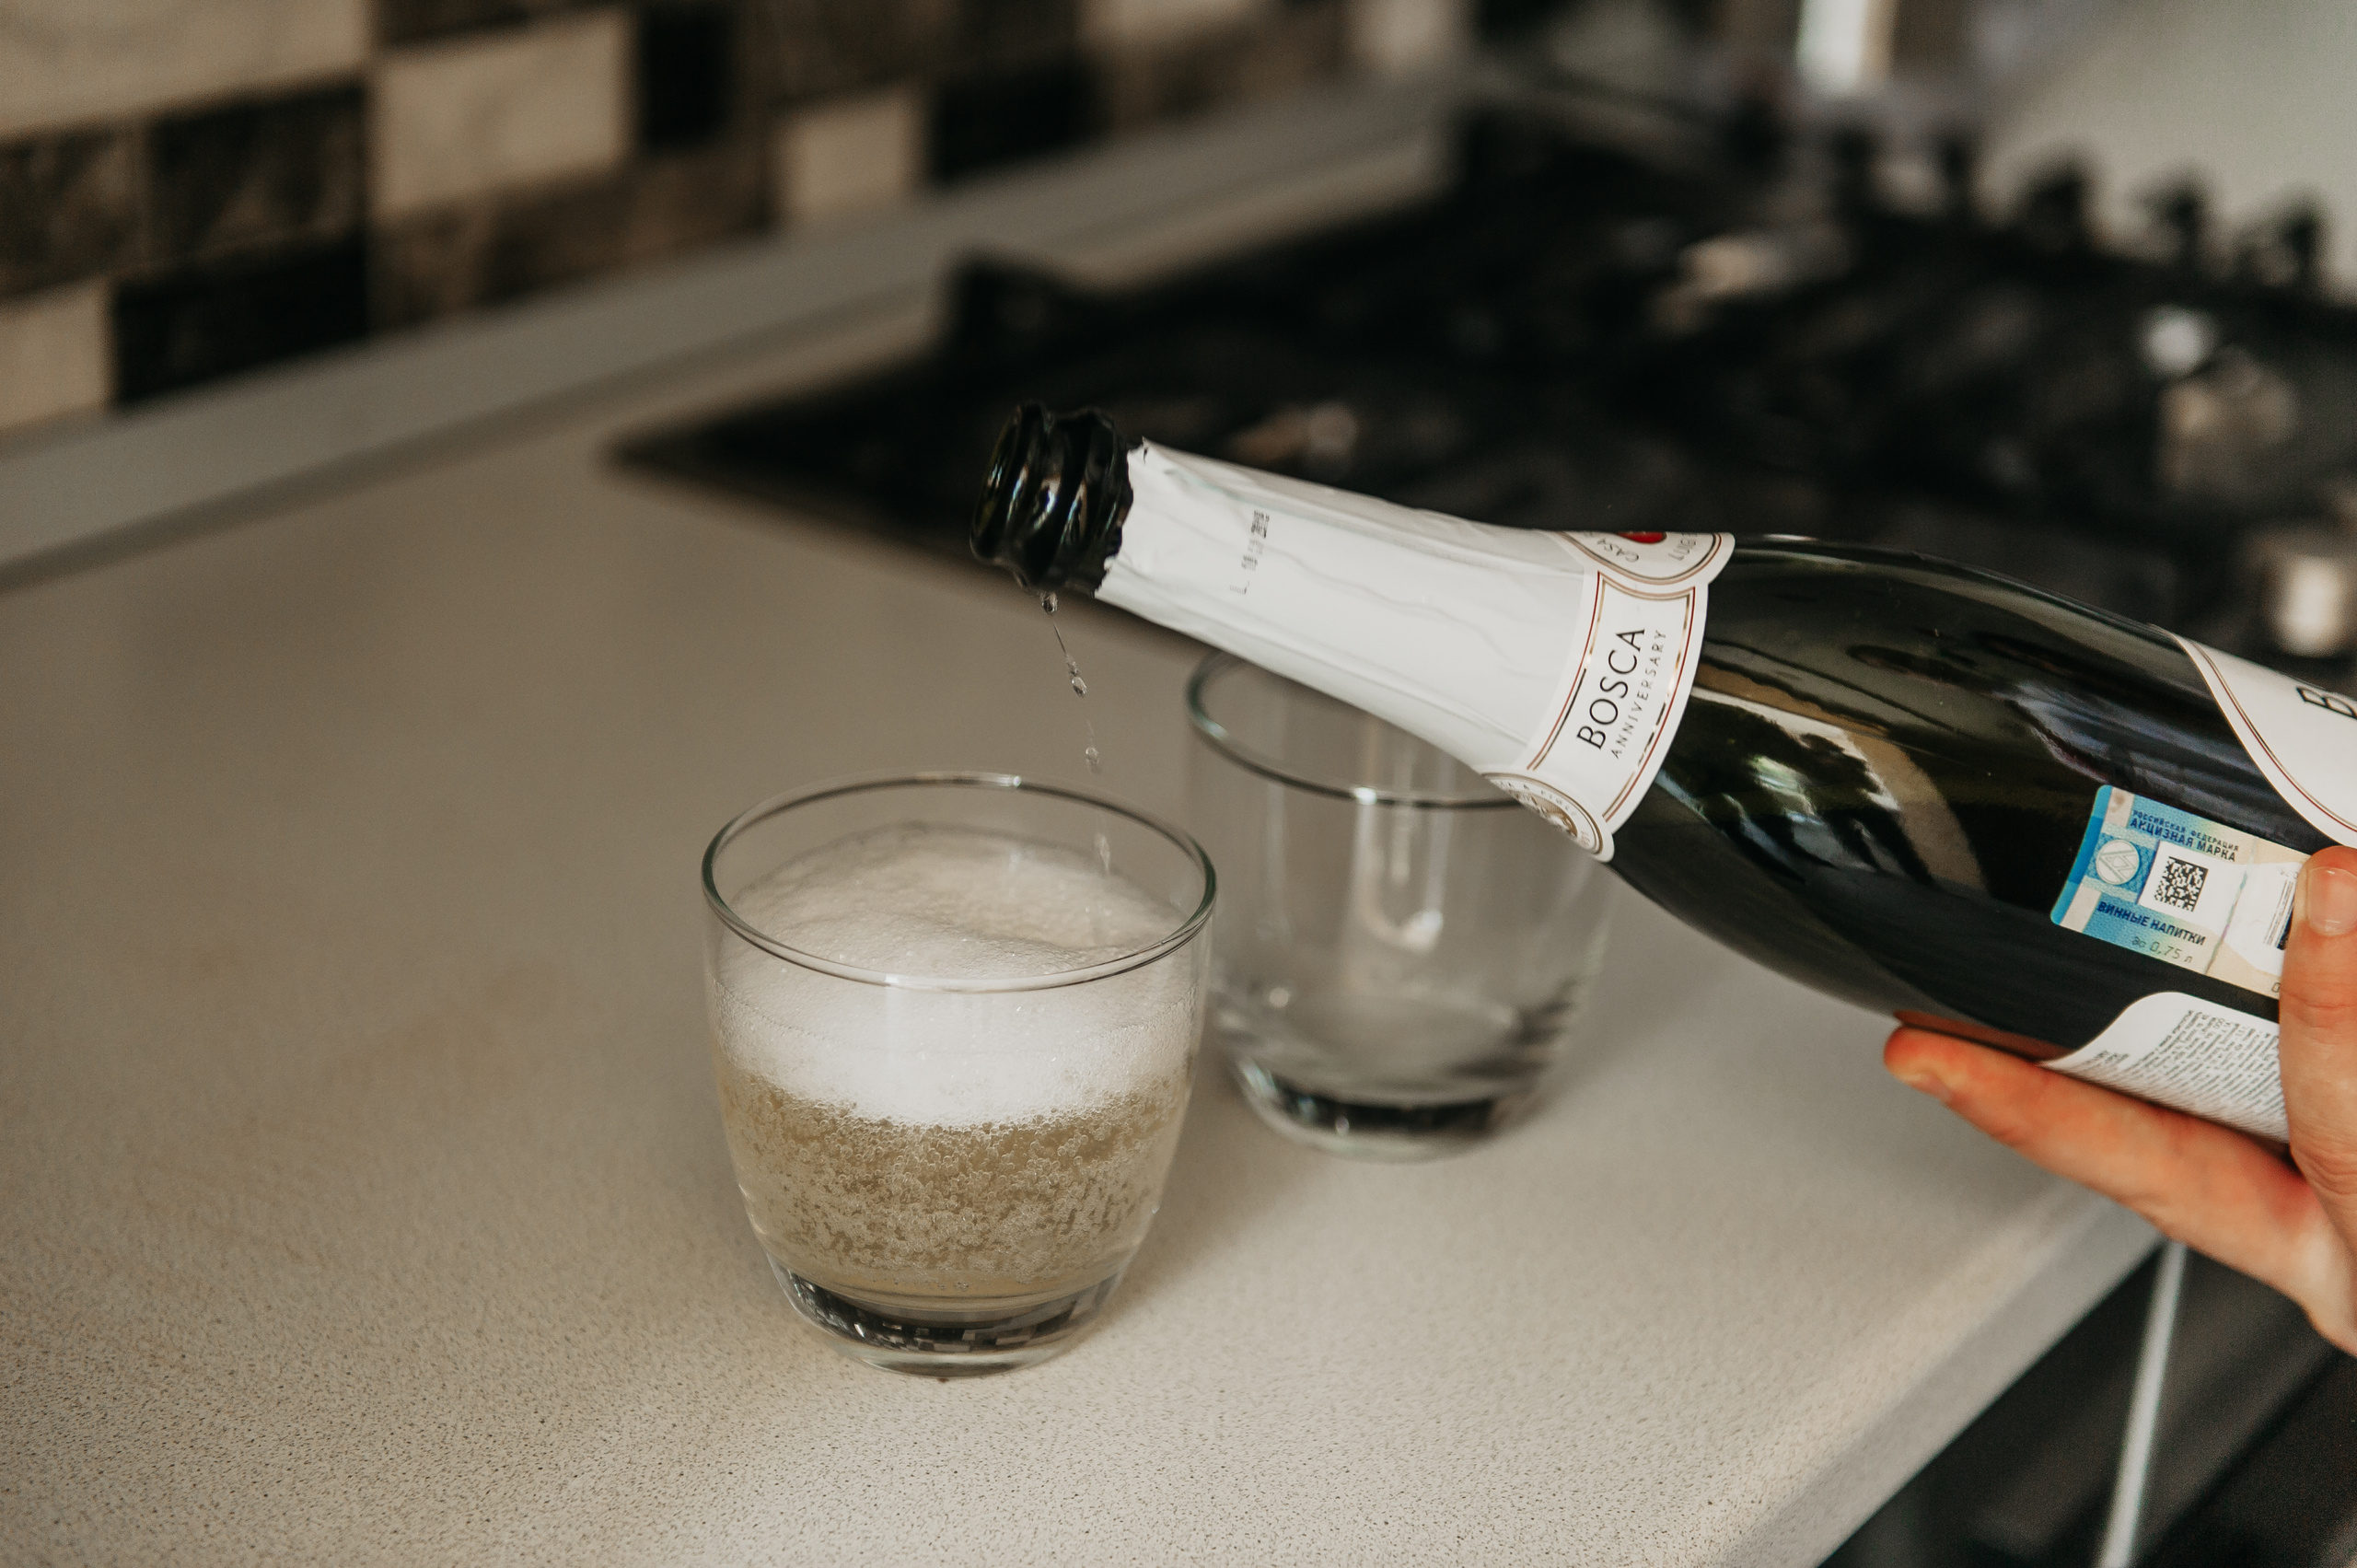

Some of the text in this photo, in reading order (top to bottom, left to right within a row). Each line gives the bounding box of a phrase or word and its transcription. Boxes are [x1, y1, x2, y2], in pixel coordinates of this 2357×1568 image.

[1576, 629, 1645, 750] BOSCA
[1611, 630, 1666, 760] ANNIVERSARY
[2130, 818, 2235, 862] АКЦИЗНАЯ МАРКА
[2132, 810, 2239, 852] РОССИЙСКАЯ ФЕДЕРАЦИЯ
[2096, 901, 2206, 947] ВИННЫЕ НАПИТКИ
[2150, 940, 2183, 959] 0,75
[2184, 955, 2193, 964] л
